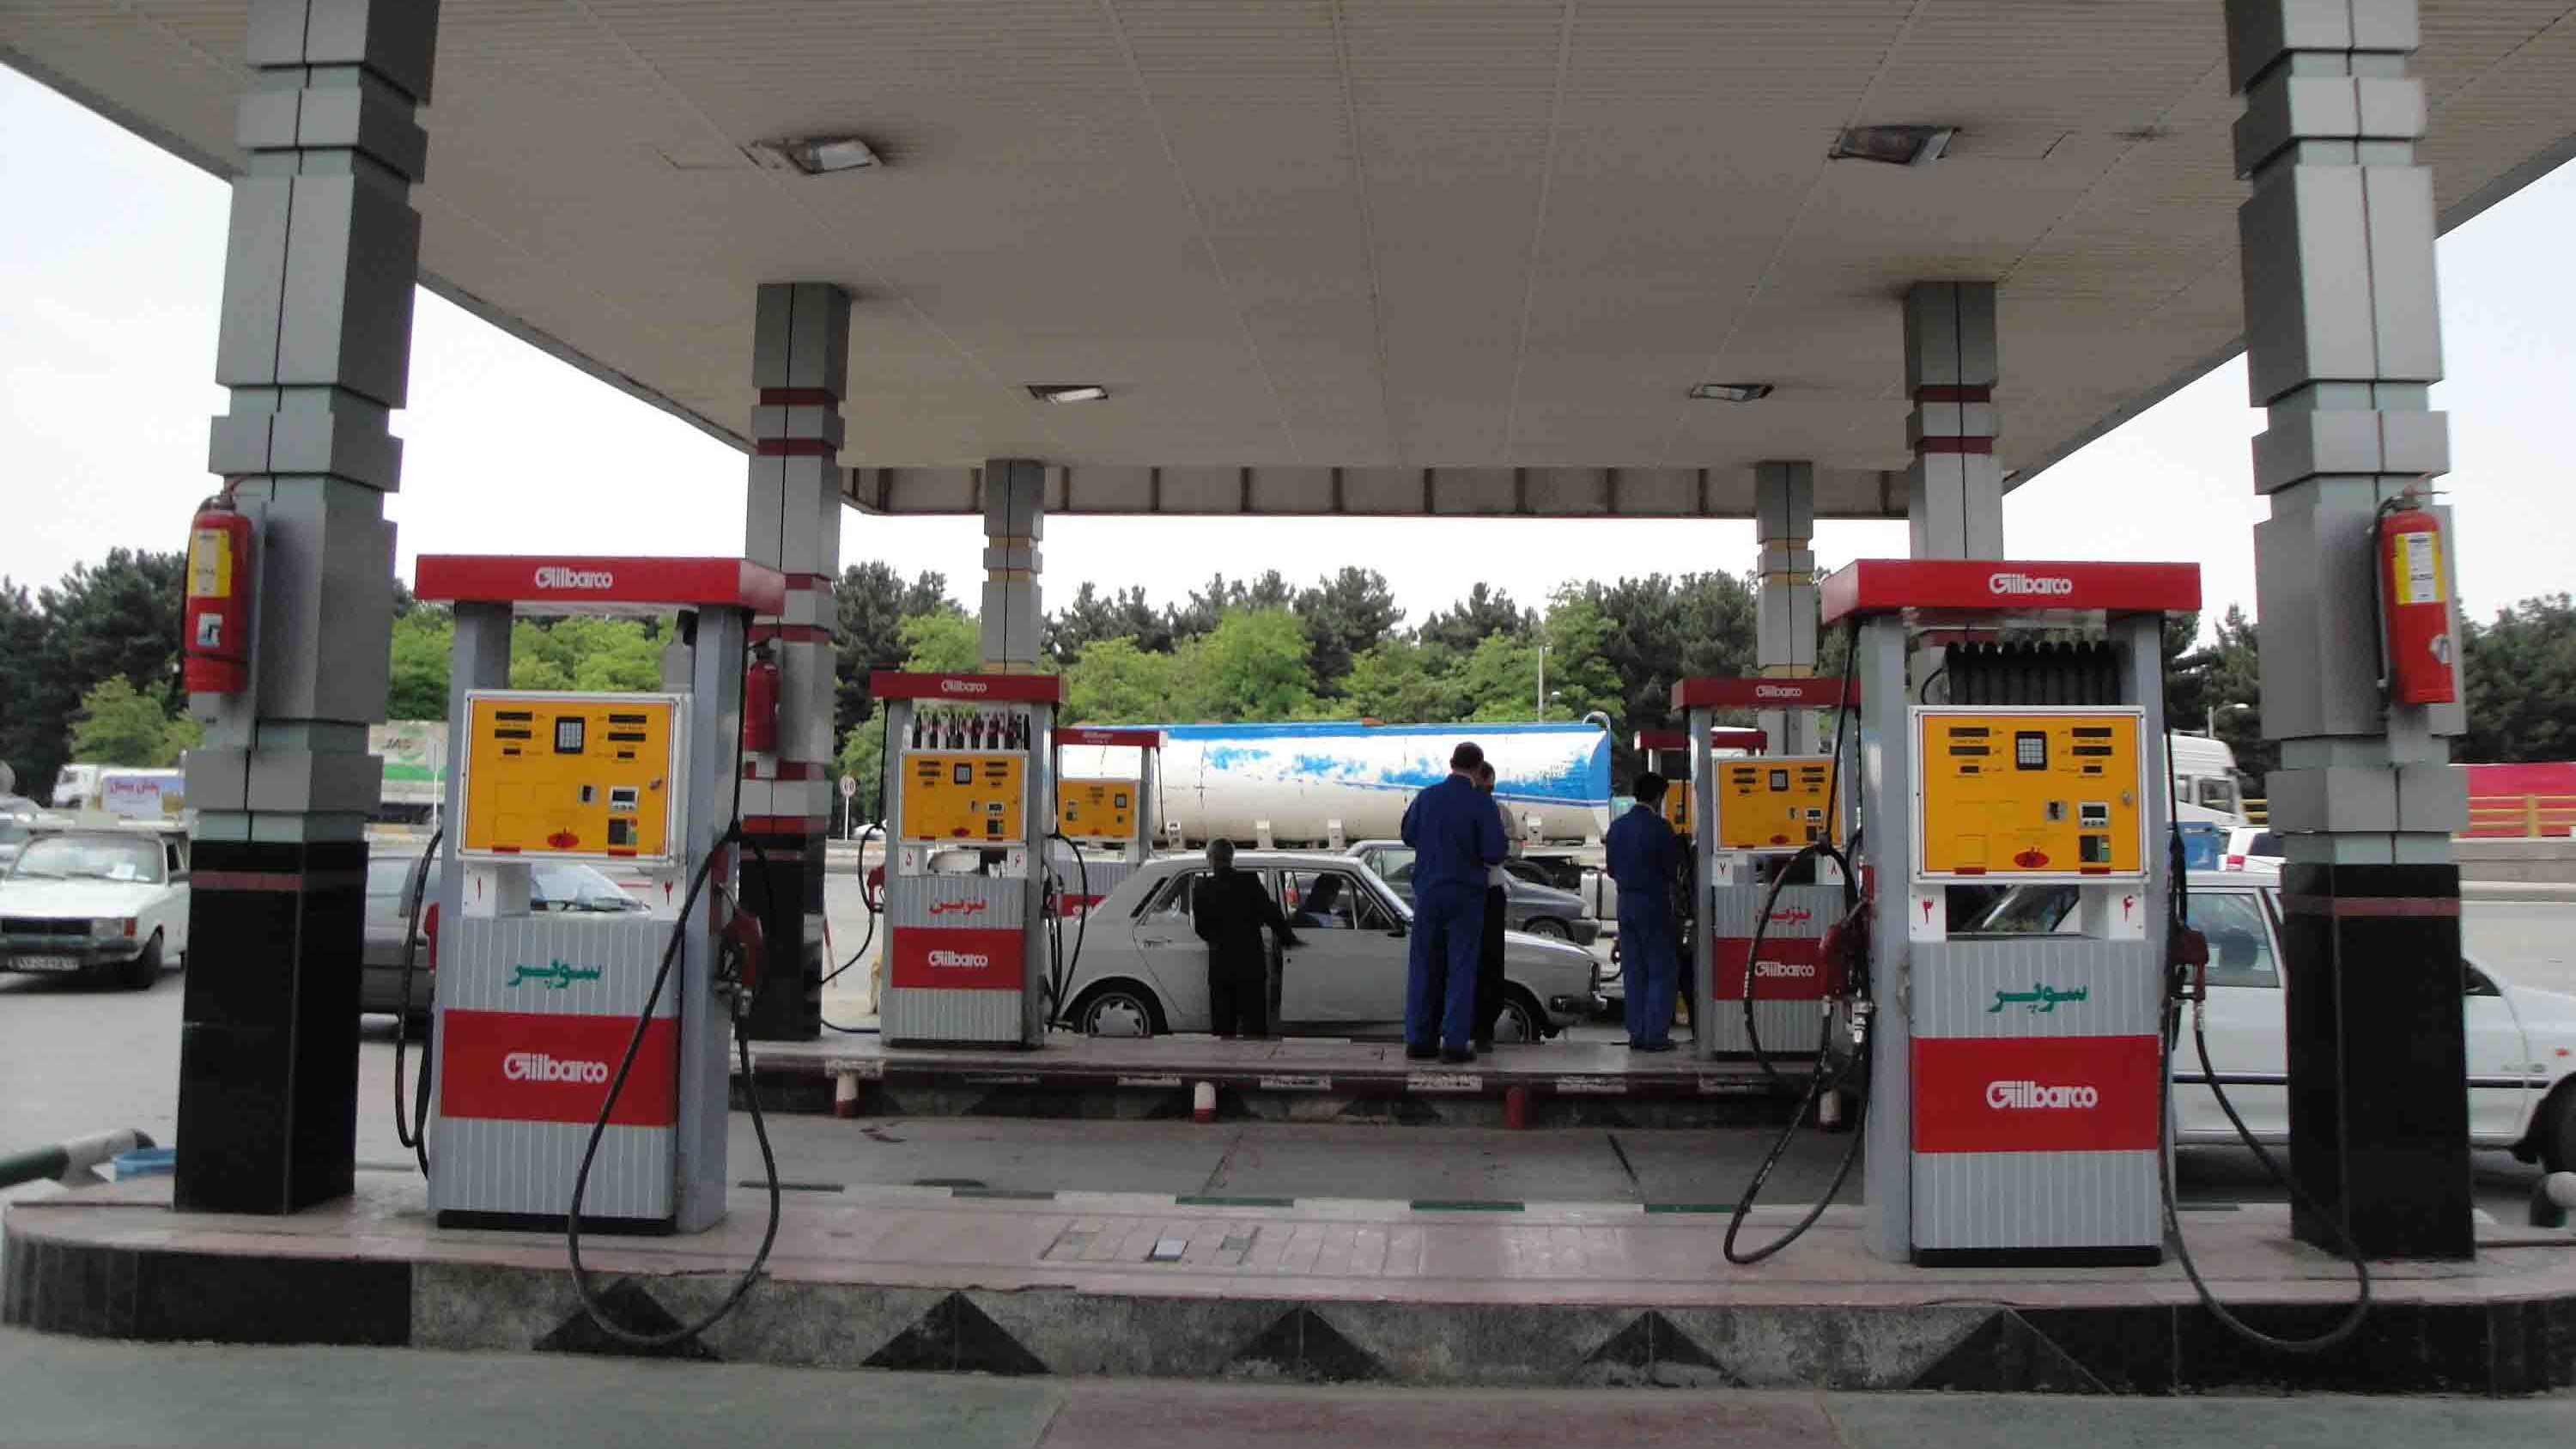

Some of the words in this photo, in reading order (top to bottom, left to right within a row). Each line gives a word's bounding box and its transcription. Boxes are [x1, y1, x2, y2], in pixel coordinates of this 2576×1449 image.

[536, 566, 613, 588] Gilbarco
[1989, 573, 2073, 594] Gilbarco
[941, 679, 987, 692] Gilbarco
[1756, 685, 1802, 697] Gilbarco
[1922, 896, 1935, 924] ۳
[2122, 895, 2134, 922] ۴
[928, 950, 988, 968] Gilbarco
[1753, 960, 1815, 977] Gilbarco
[507, 958, 604, 990] سوپر
[1986, 981, 2089, 1014] سوپر
[503, 1052, 608, 1083] Gilbarco
[1986, 1081, 2098, 1109] Gilbarco
